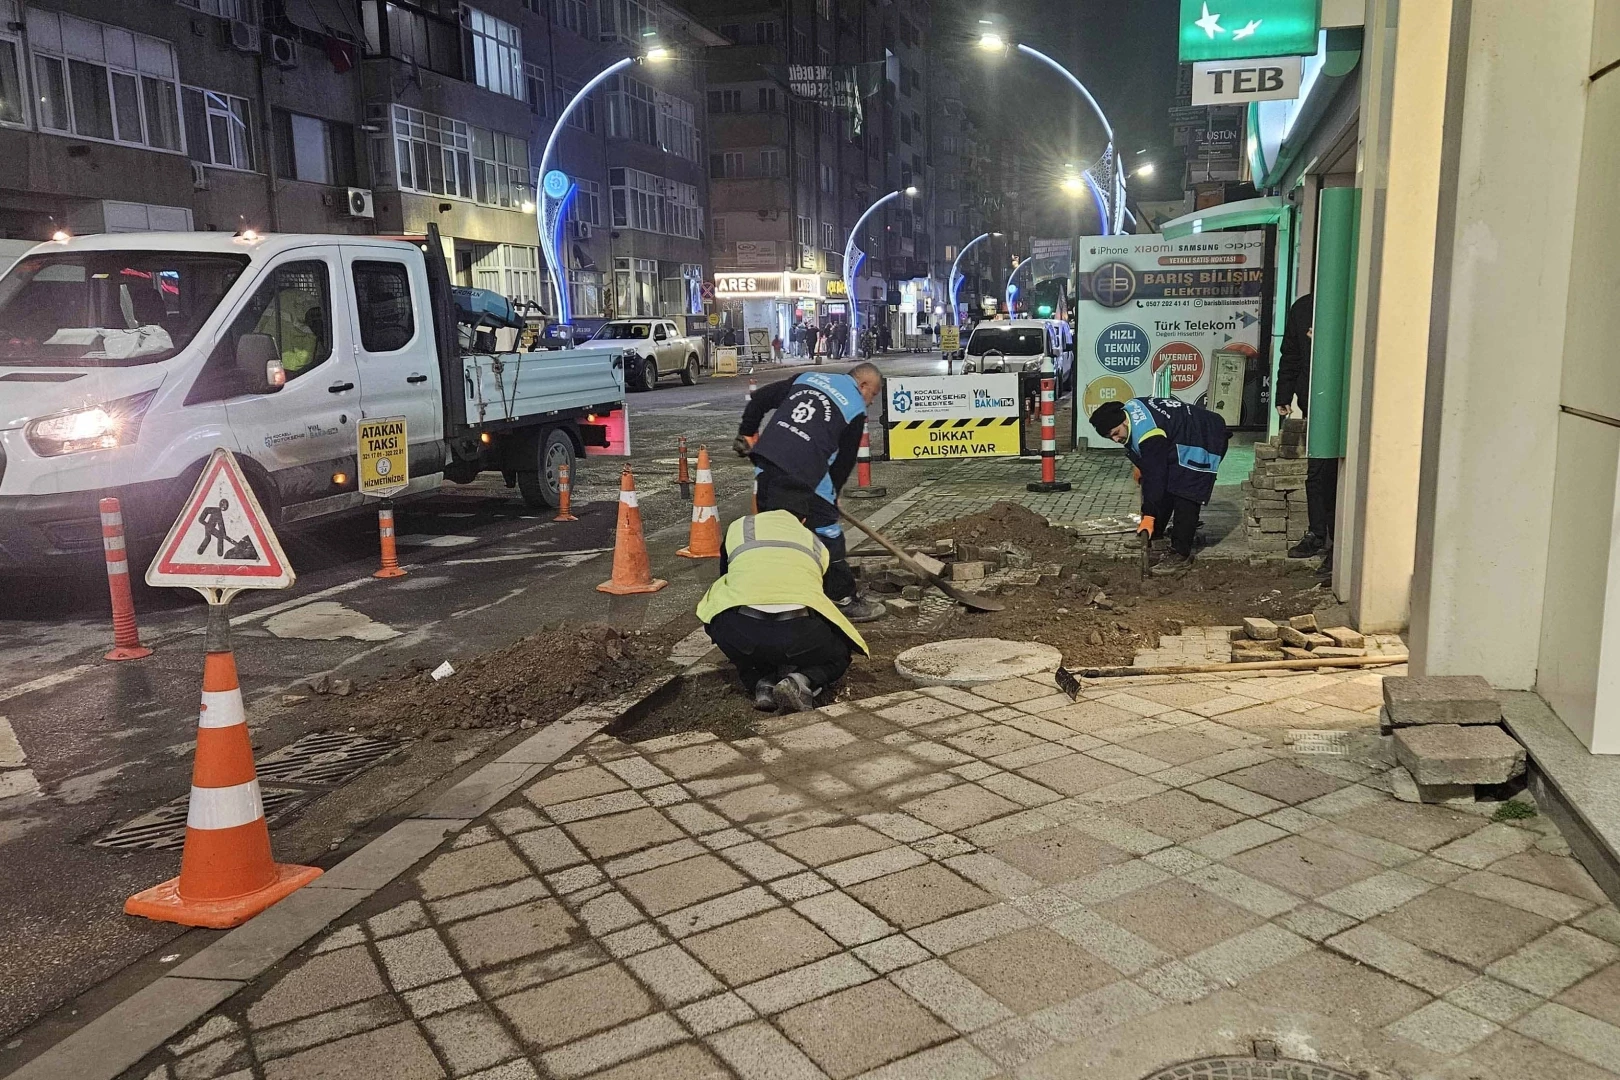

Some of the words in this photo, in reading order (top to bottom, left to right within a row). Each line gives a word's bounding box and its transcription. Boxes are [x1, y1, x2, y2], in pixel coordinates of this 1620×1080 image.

[1207, 67, 1284, 94] TEB
[1098, 246, 1128, 254] iPhone
[1144, 272, 1194, 286] BARIŞ
[1200, 269, 1261, 285] BİLİŞİM
[1164, 286, 1242, 296] ELEKTRONİK
[1154, 321, 1180, 330] Türk
[1184, 320, 1236, 330] Telekom
[1110, 330, 1136, 340] HIZLI
[1104, 342, 1141, 353] TEKNİK
[1104, 355, 1140, 366] SERVİS
[973, 389, 990, 398] YOL
[1100, 388, 1116, 399] CEP
[362, 423, 403, 439] ATAKAN
[930, 430, 974, 442] DİKKAT
[368, 436, 398, 451] TAKSİ
[913, 444, 968, 457] ÇALIŞMA
[971, 444, 996, 453] VAR
[364, 475, 404, 488] HİZMETİNİZDE
